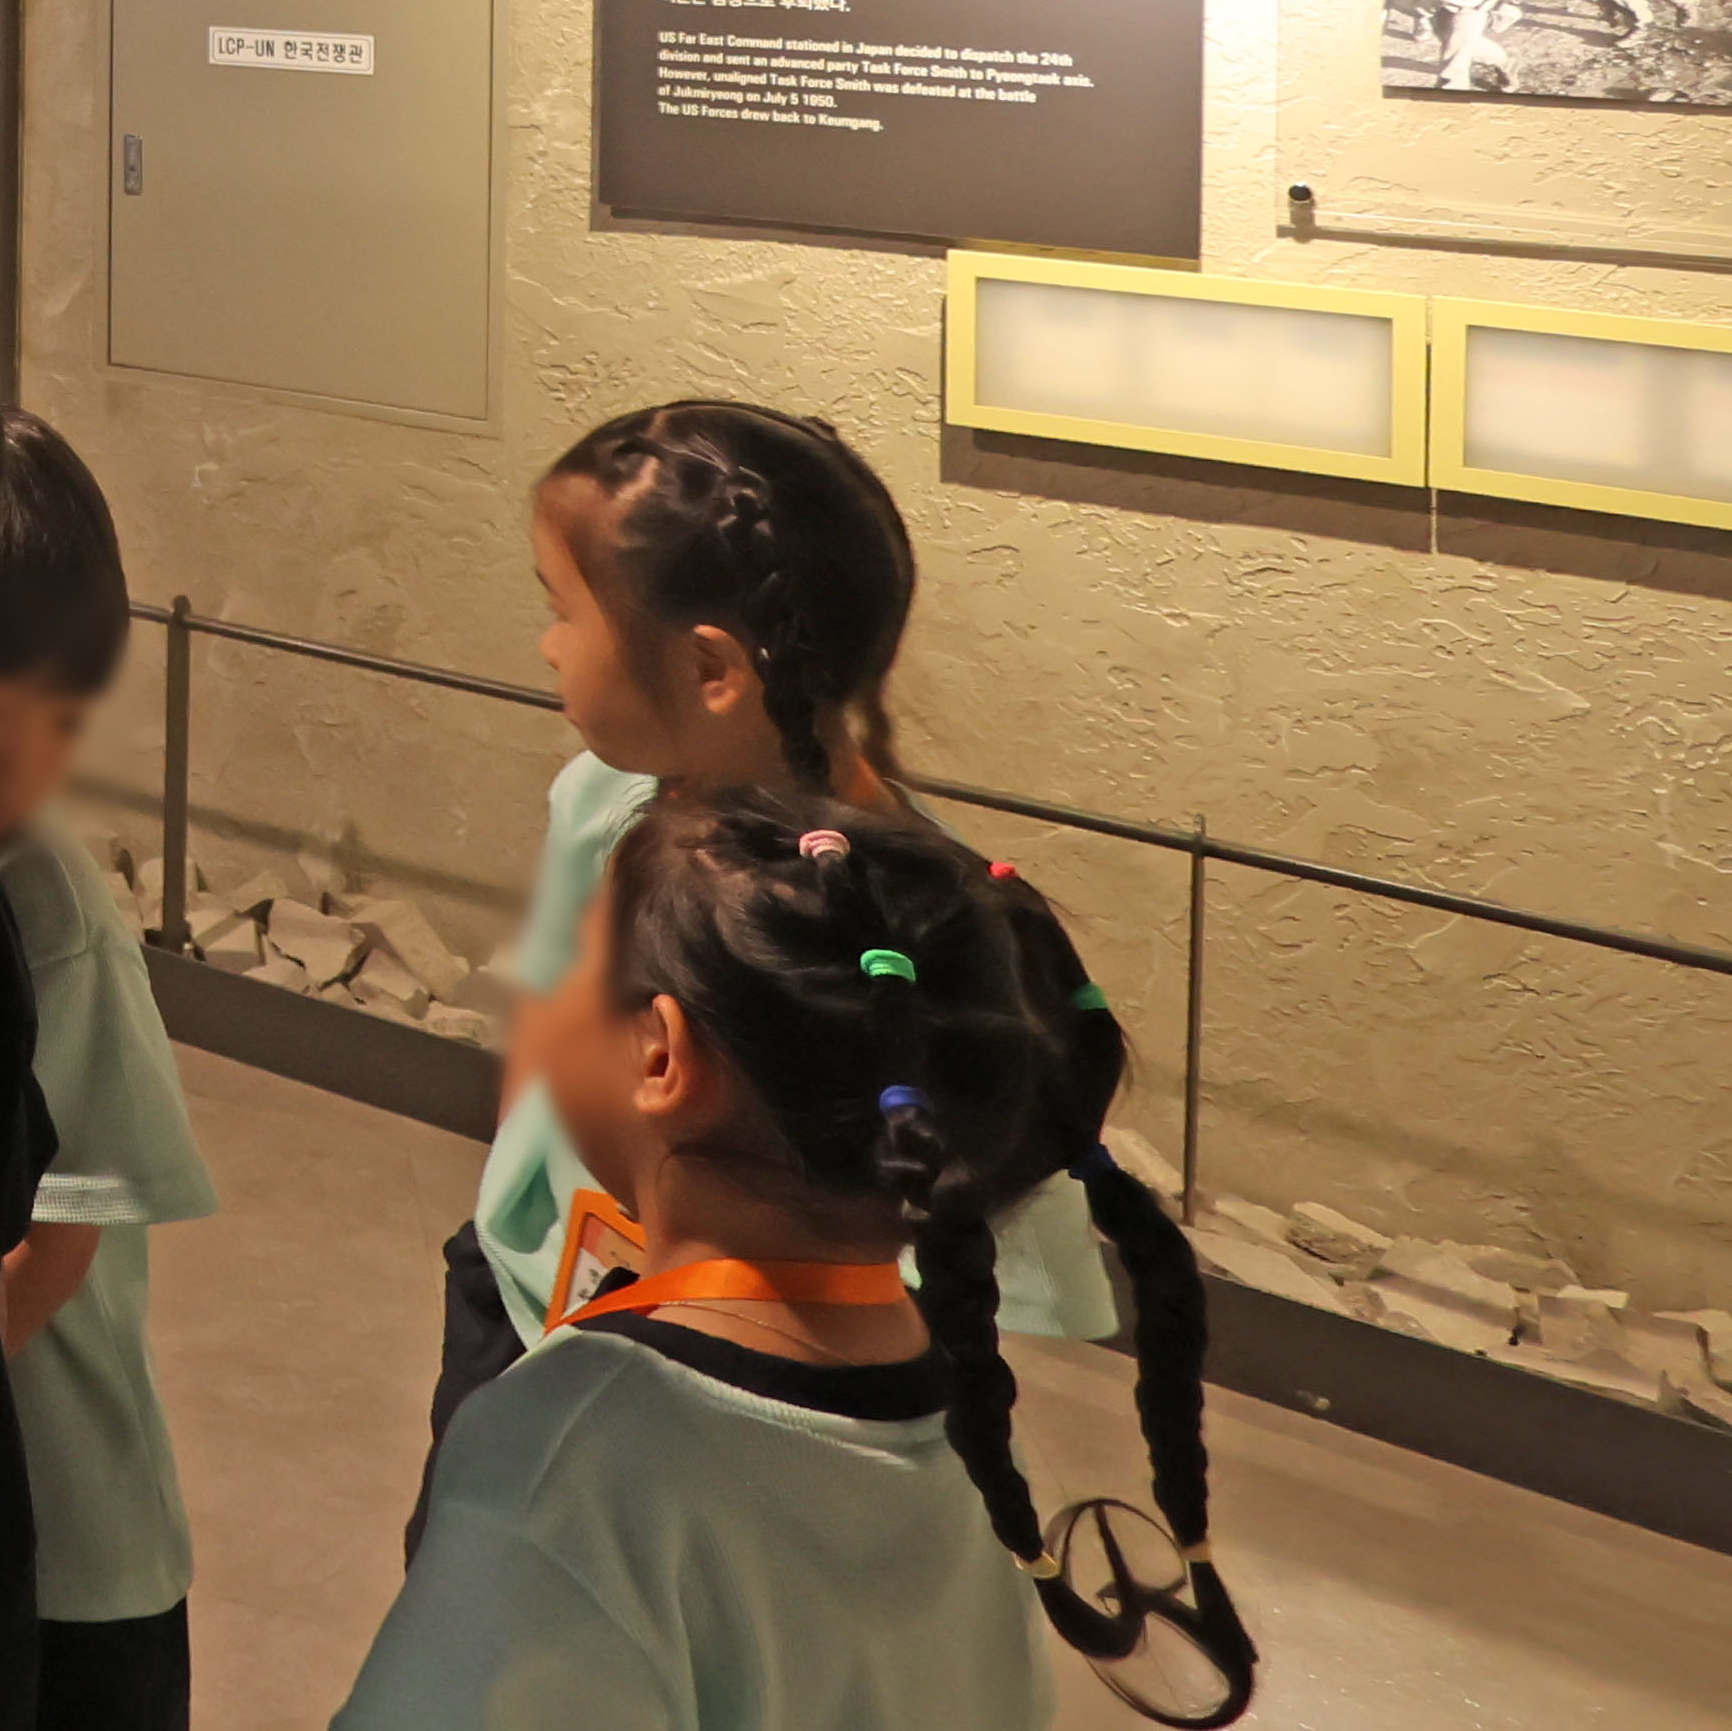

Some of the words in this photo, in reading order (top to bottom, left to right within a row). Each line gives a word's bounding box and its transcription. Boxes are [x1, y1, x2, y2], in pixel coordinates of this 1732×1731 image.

[218, 37, 275, 58] LCP-UN
[284, 40, 364, 65] 한국전쟁관
[658, 31, 676, 44] US
[678, 32, 696, 45] Far
[699, 33, 724, 47] East
[727, 34, 783, 50] Command
[785, 38, 839, 53] stationed
[841, 40, 853, 54] in
[855, 42, 893, 57] Japan
[895, 44, 942, 59] decided
[944, 47, 958, 60] to
[960, 48, 1014, 63] dispatch
[1016, 50, 1038, 65] the
[1040, 51, 1073, 67] 24th
[658, 50, 700, 62] division
[702, 52, 723, 65] and
[726, 53, 750, 66] sent
[752, 55, 768, 67] an
[770, 55, 825, 70] advanced
[826, 59, 859, 75] party
[862, 60, 891, 74] Task
[893, 62, 928, 77] Force
[930, 64, 968, 80] Smith
[970, 67, 984, 81] to
[986, 68, 1061, 86] Pyeongtaek
[1063, 73, 1095, 88] axis.
[658, 66, 712, 83] However,
[713, 71, 767, 86] unaligned
[769, 73, 798, 87] Task
[800, 75, 833, 90] Force
[836, 77, 871, 92] Smith
[873, 81, 899, 94] was
[901, 82, 956, 98] defeated
[958, 86, 972, 99] at
[975, 87, 996, 101] the
[997, 88, 1037, 104] battle
[657, 84, 671, 97] of
[673, 86, 744, 104] Jukmiryeong
[746, 92, 761, 103] on
[763, 91, 788, 107] July
[790, 92, 799, 105] 5
[802, 93, 838, 109] 1950.
[657, 101, 679, 116] The
[682, 103, 699, 117] US
[701, 104, 739, 119] Forces
[741, 108, 770, 122] drew
[773, 108, 800, 124] back
[803, 111, 817, 125] to
[818, 113, 885, 132] Keumgang.
